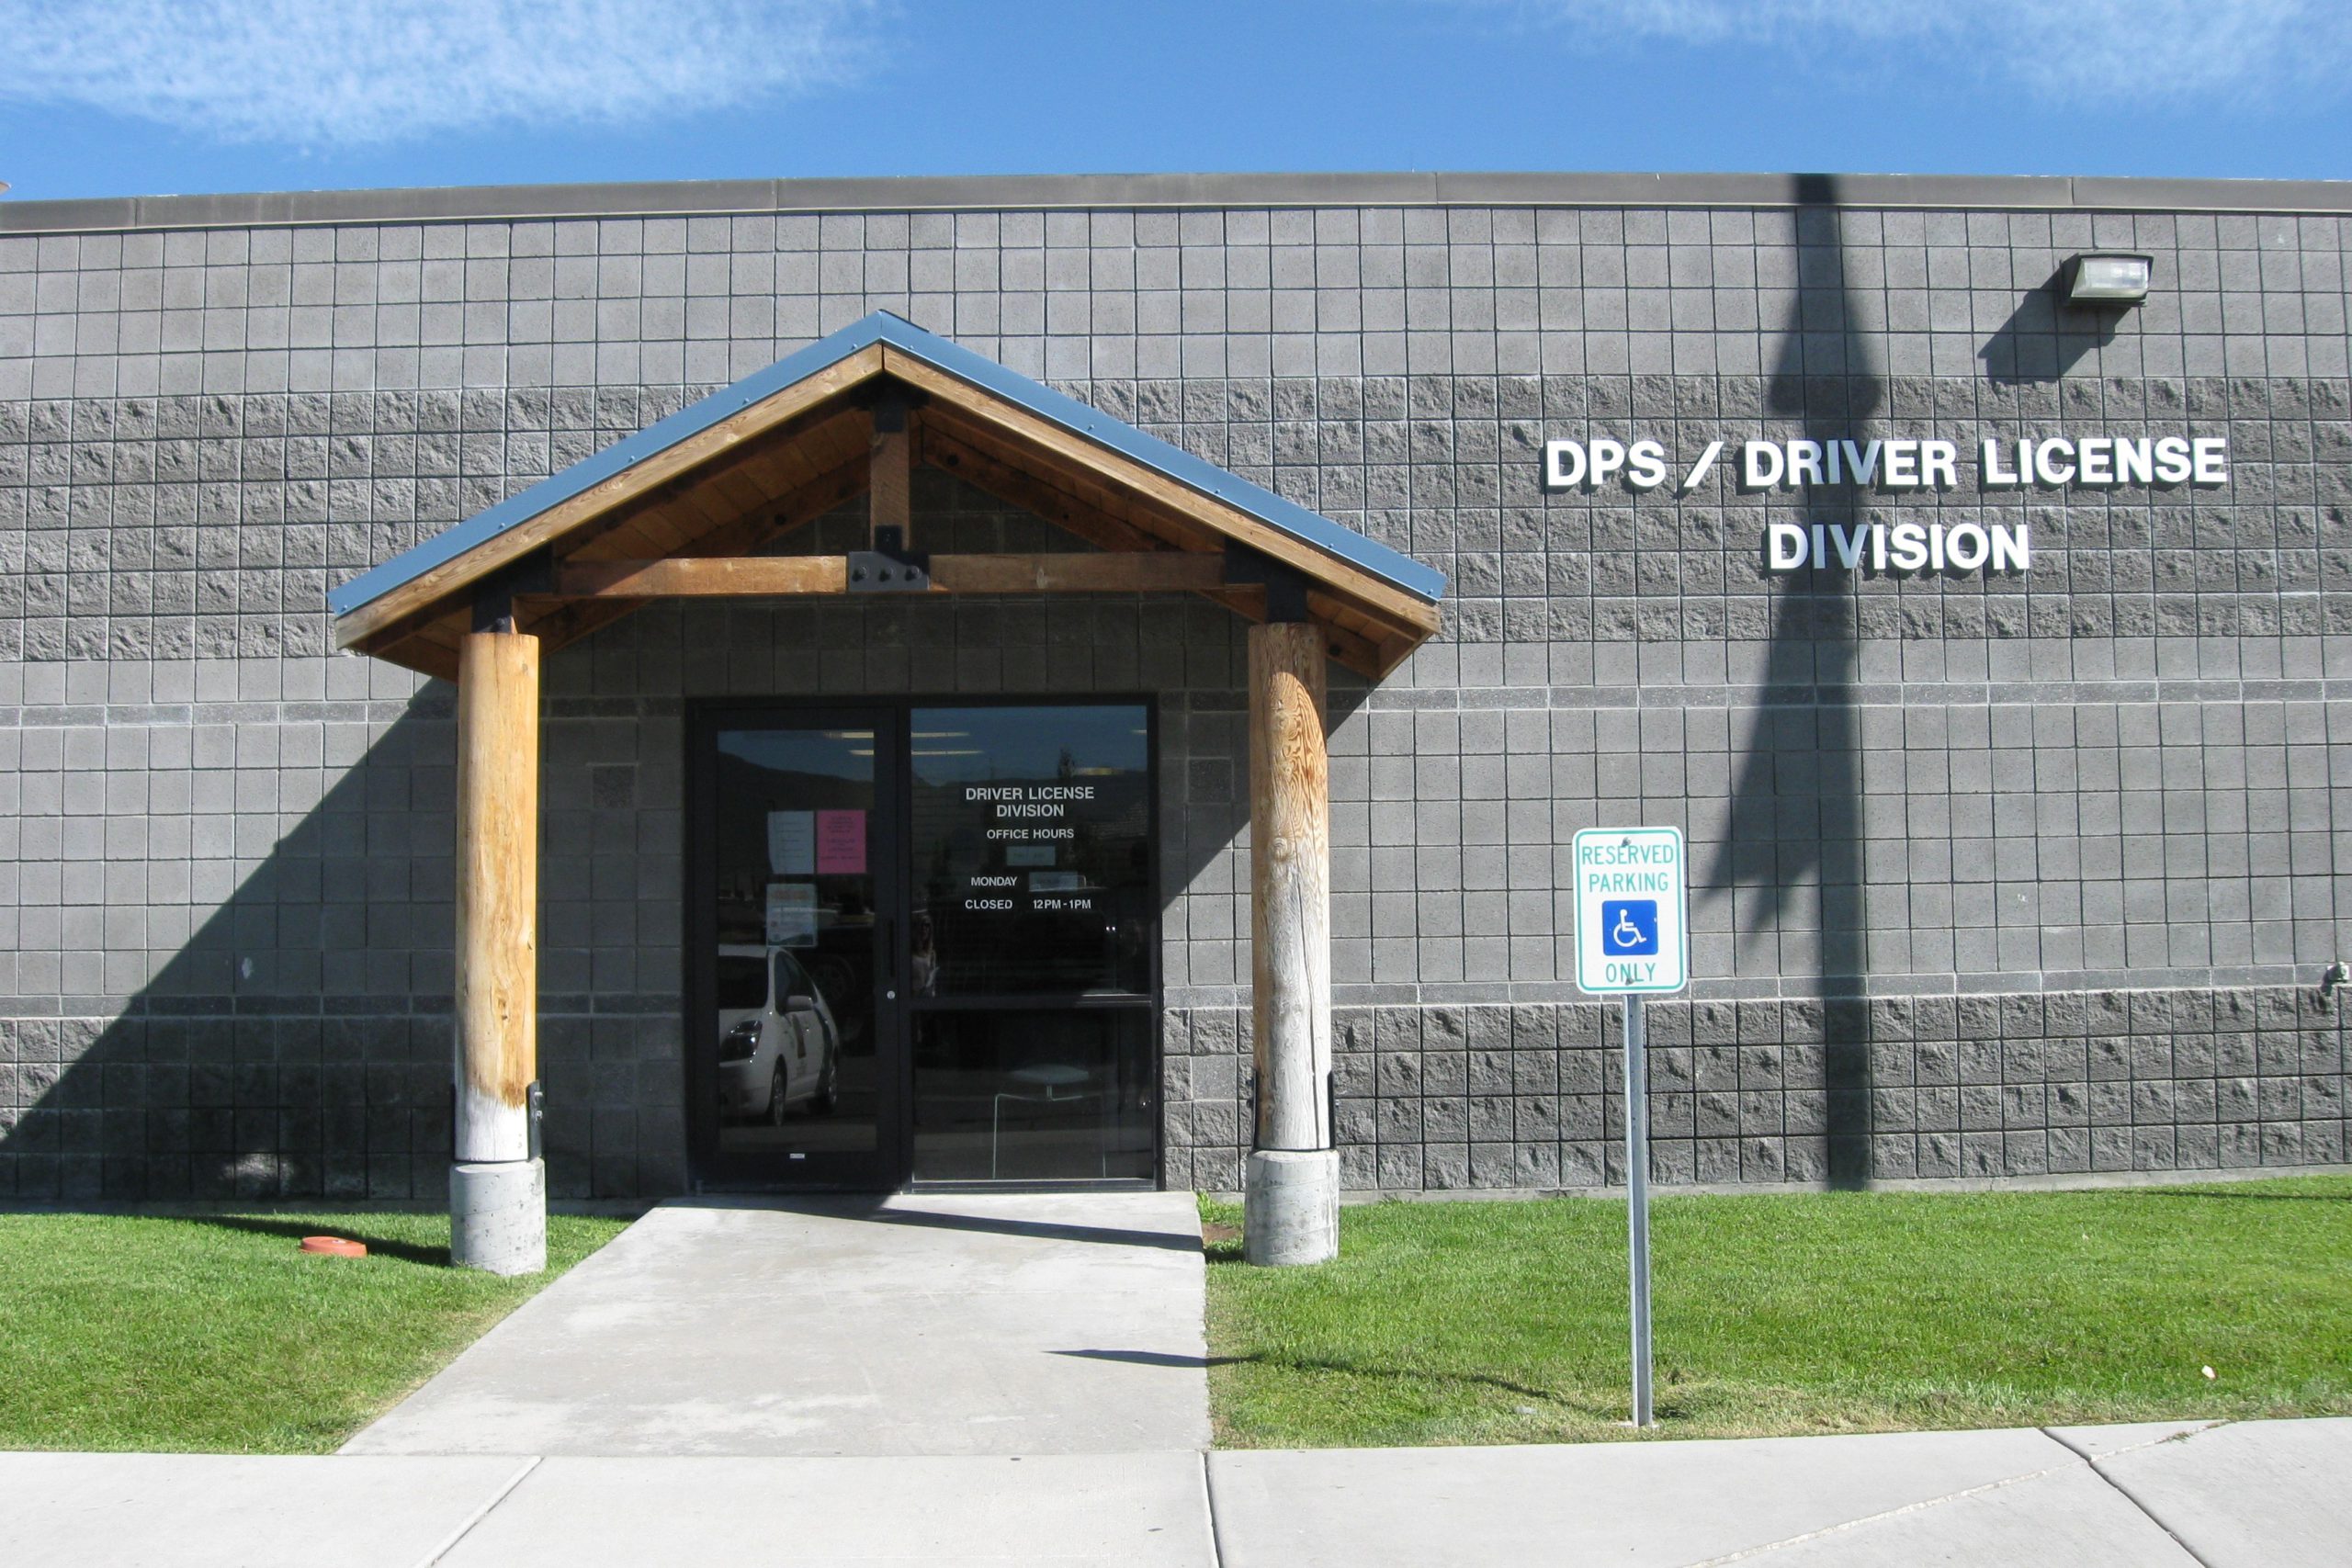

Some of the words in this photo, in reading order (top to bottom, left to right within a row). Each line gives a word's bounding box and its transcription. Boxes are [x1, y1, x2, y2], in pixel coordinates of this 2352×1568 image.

[1545, 440, 1666, 489] DPS
[1683, 441, 1724, 489] /
[1744, 439, 1958, 488] DRIVER
[1984, 437, 2228, 486] LICENSE
[1768, 523, 2030, 571] DIVISION
[966, 787, 1023, 800] DRIVER
[1029, 786, 1094, 800] LICENSE
[997, 804, 1064, 818] DIVISION
[987, 829, 1029, 840] OFFICE
[1033, 829, 1074, 839] HOURS
[1582, 845, 1673, 864] RESERVED
[970, 876, 1017, 886] MONDAY
[1589, 872, 1668, 892] PARKING
[965, 899, 1012, 909] CLOSED
[1605, 962, 1656, 983] ONLY
